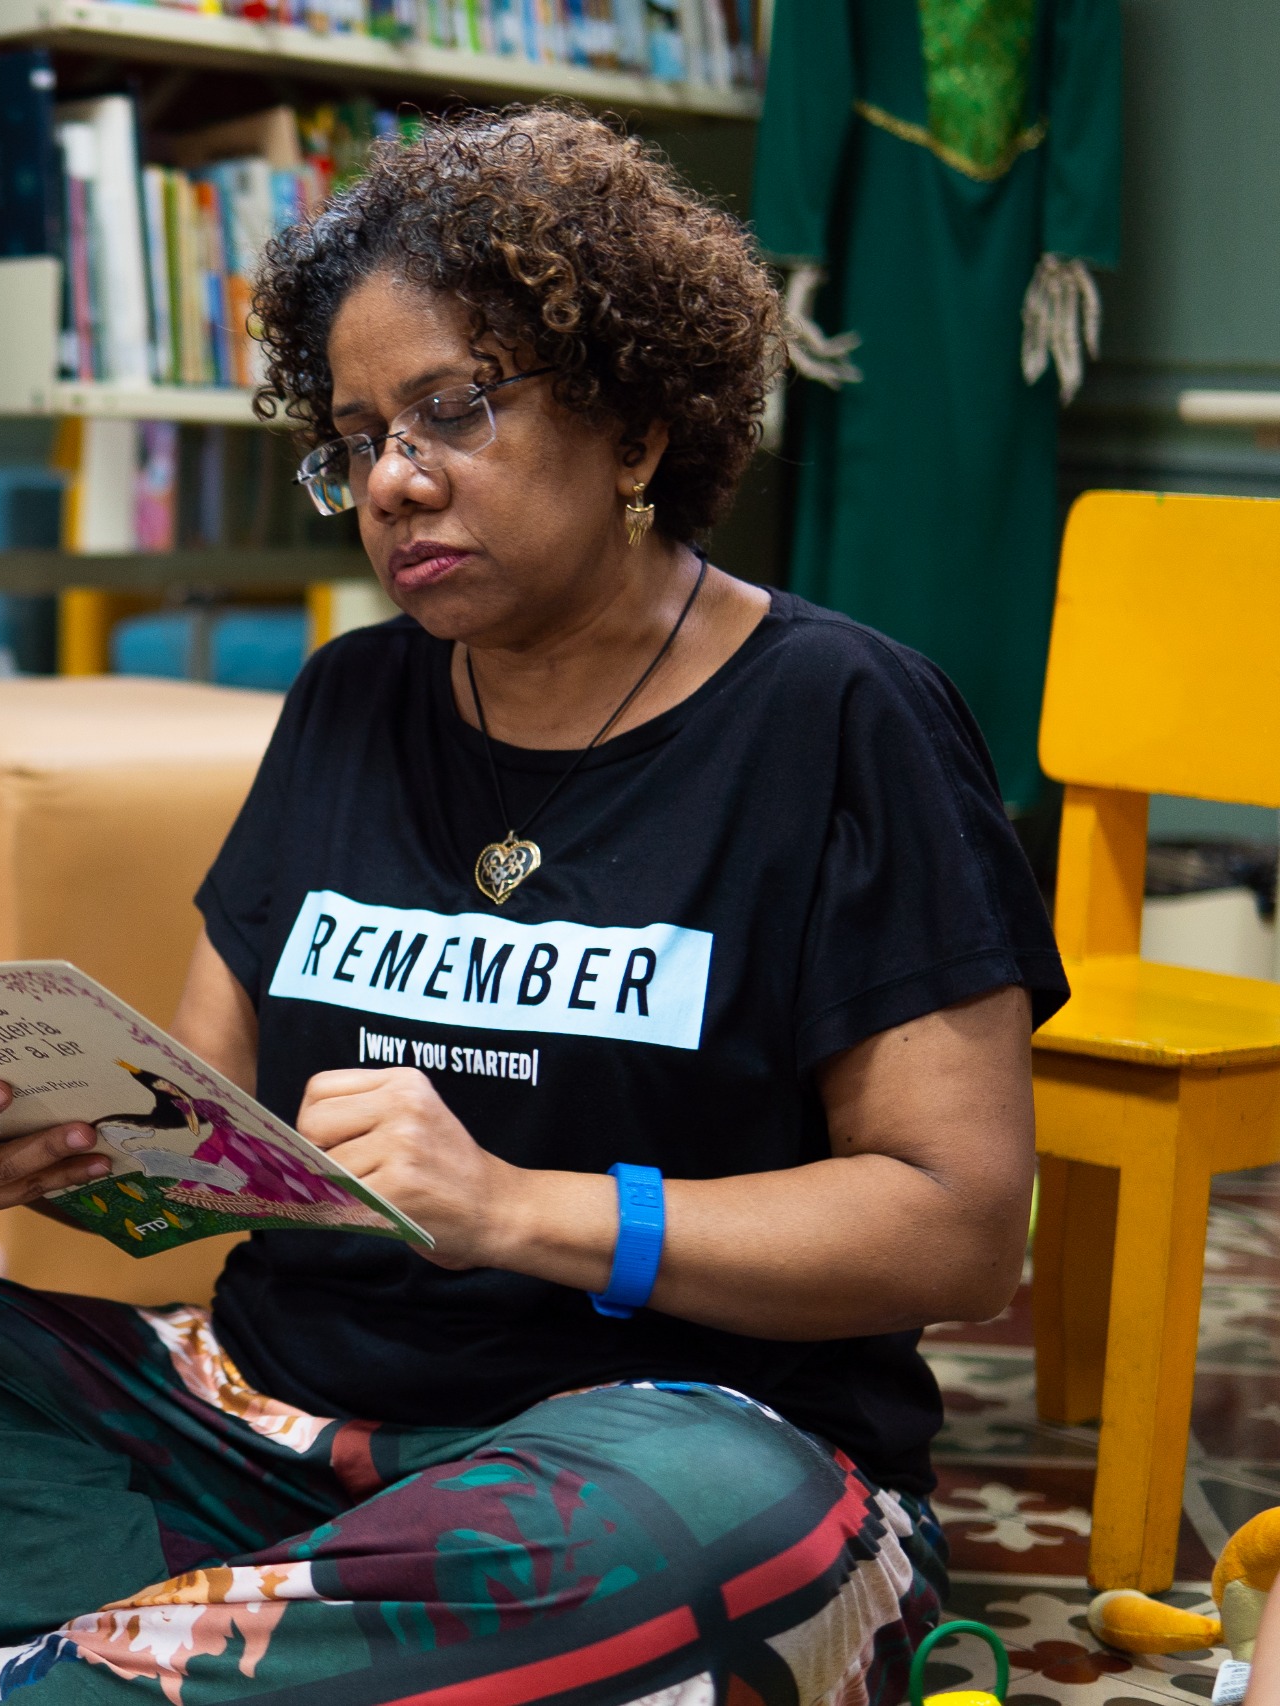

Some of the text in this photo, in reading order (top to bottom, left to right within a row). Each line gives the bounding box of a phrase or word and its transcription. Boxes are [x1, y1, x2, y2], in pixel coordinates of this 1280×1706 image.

[301, 913, 658, 1017] REMEMBER
[25, 1044, 49, 1059] a
[42, 1038, 86, 1057] ler
[411, 1040, 446, 1071] YOU
[12, 1079, 89, 1099] eloisa Prieto
[134, 1217, 169, 1236] FTD
